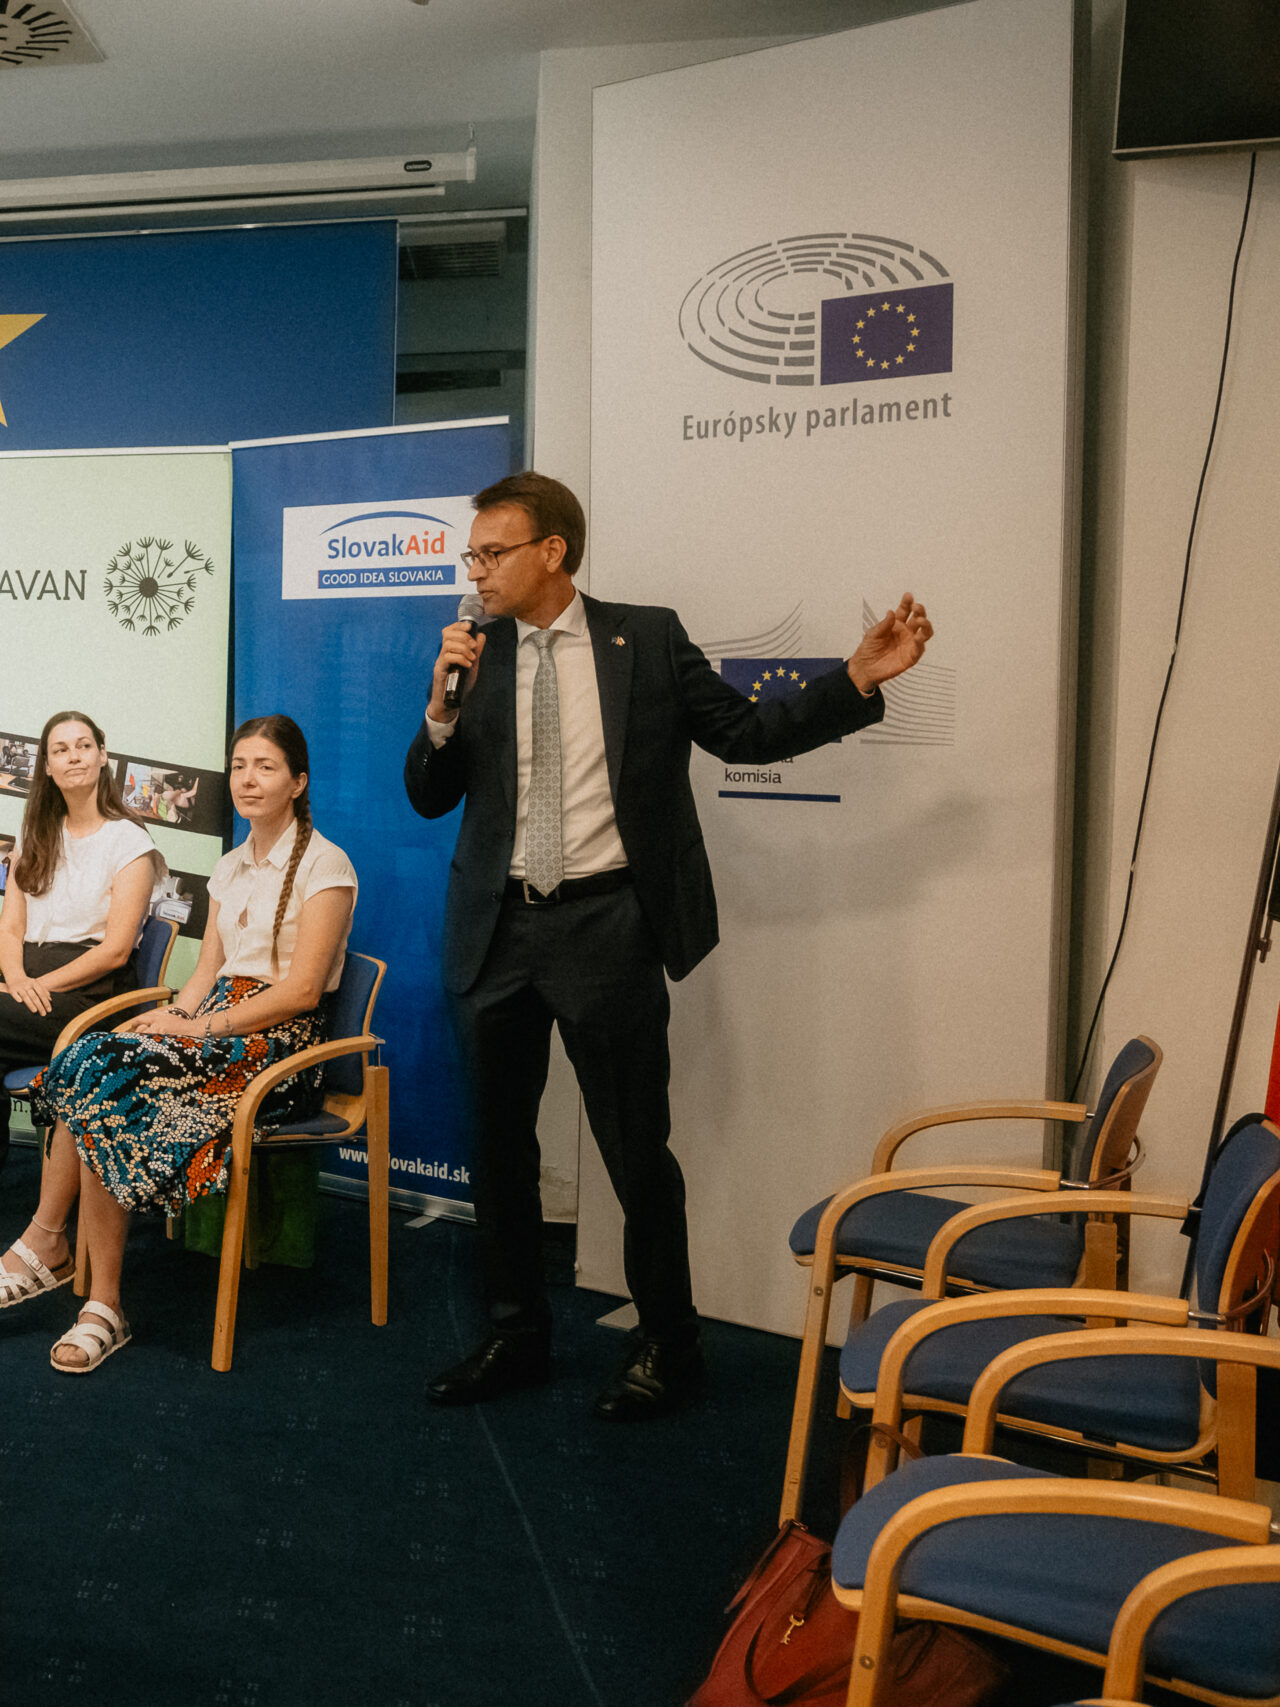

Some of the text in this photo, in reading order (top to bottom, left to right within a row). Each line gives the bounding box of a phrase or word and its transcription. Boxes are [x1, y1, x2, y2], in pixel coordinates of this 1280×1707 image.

[683, 392, 953, 442] Európsky parlament
[327, 530, 445, 559] SlovakAid
[322, 569, 444, 585] GOOD IDEA SLOVAKIA
[724, 768, 782, 784] komisia
